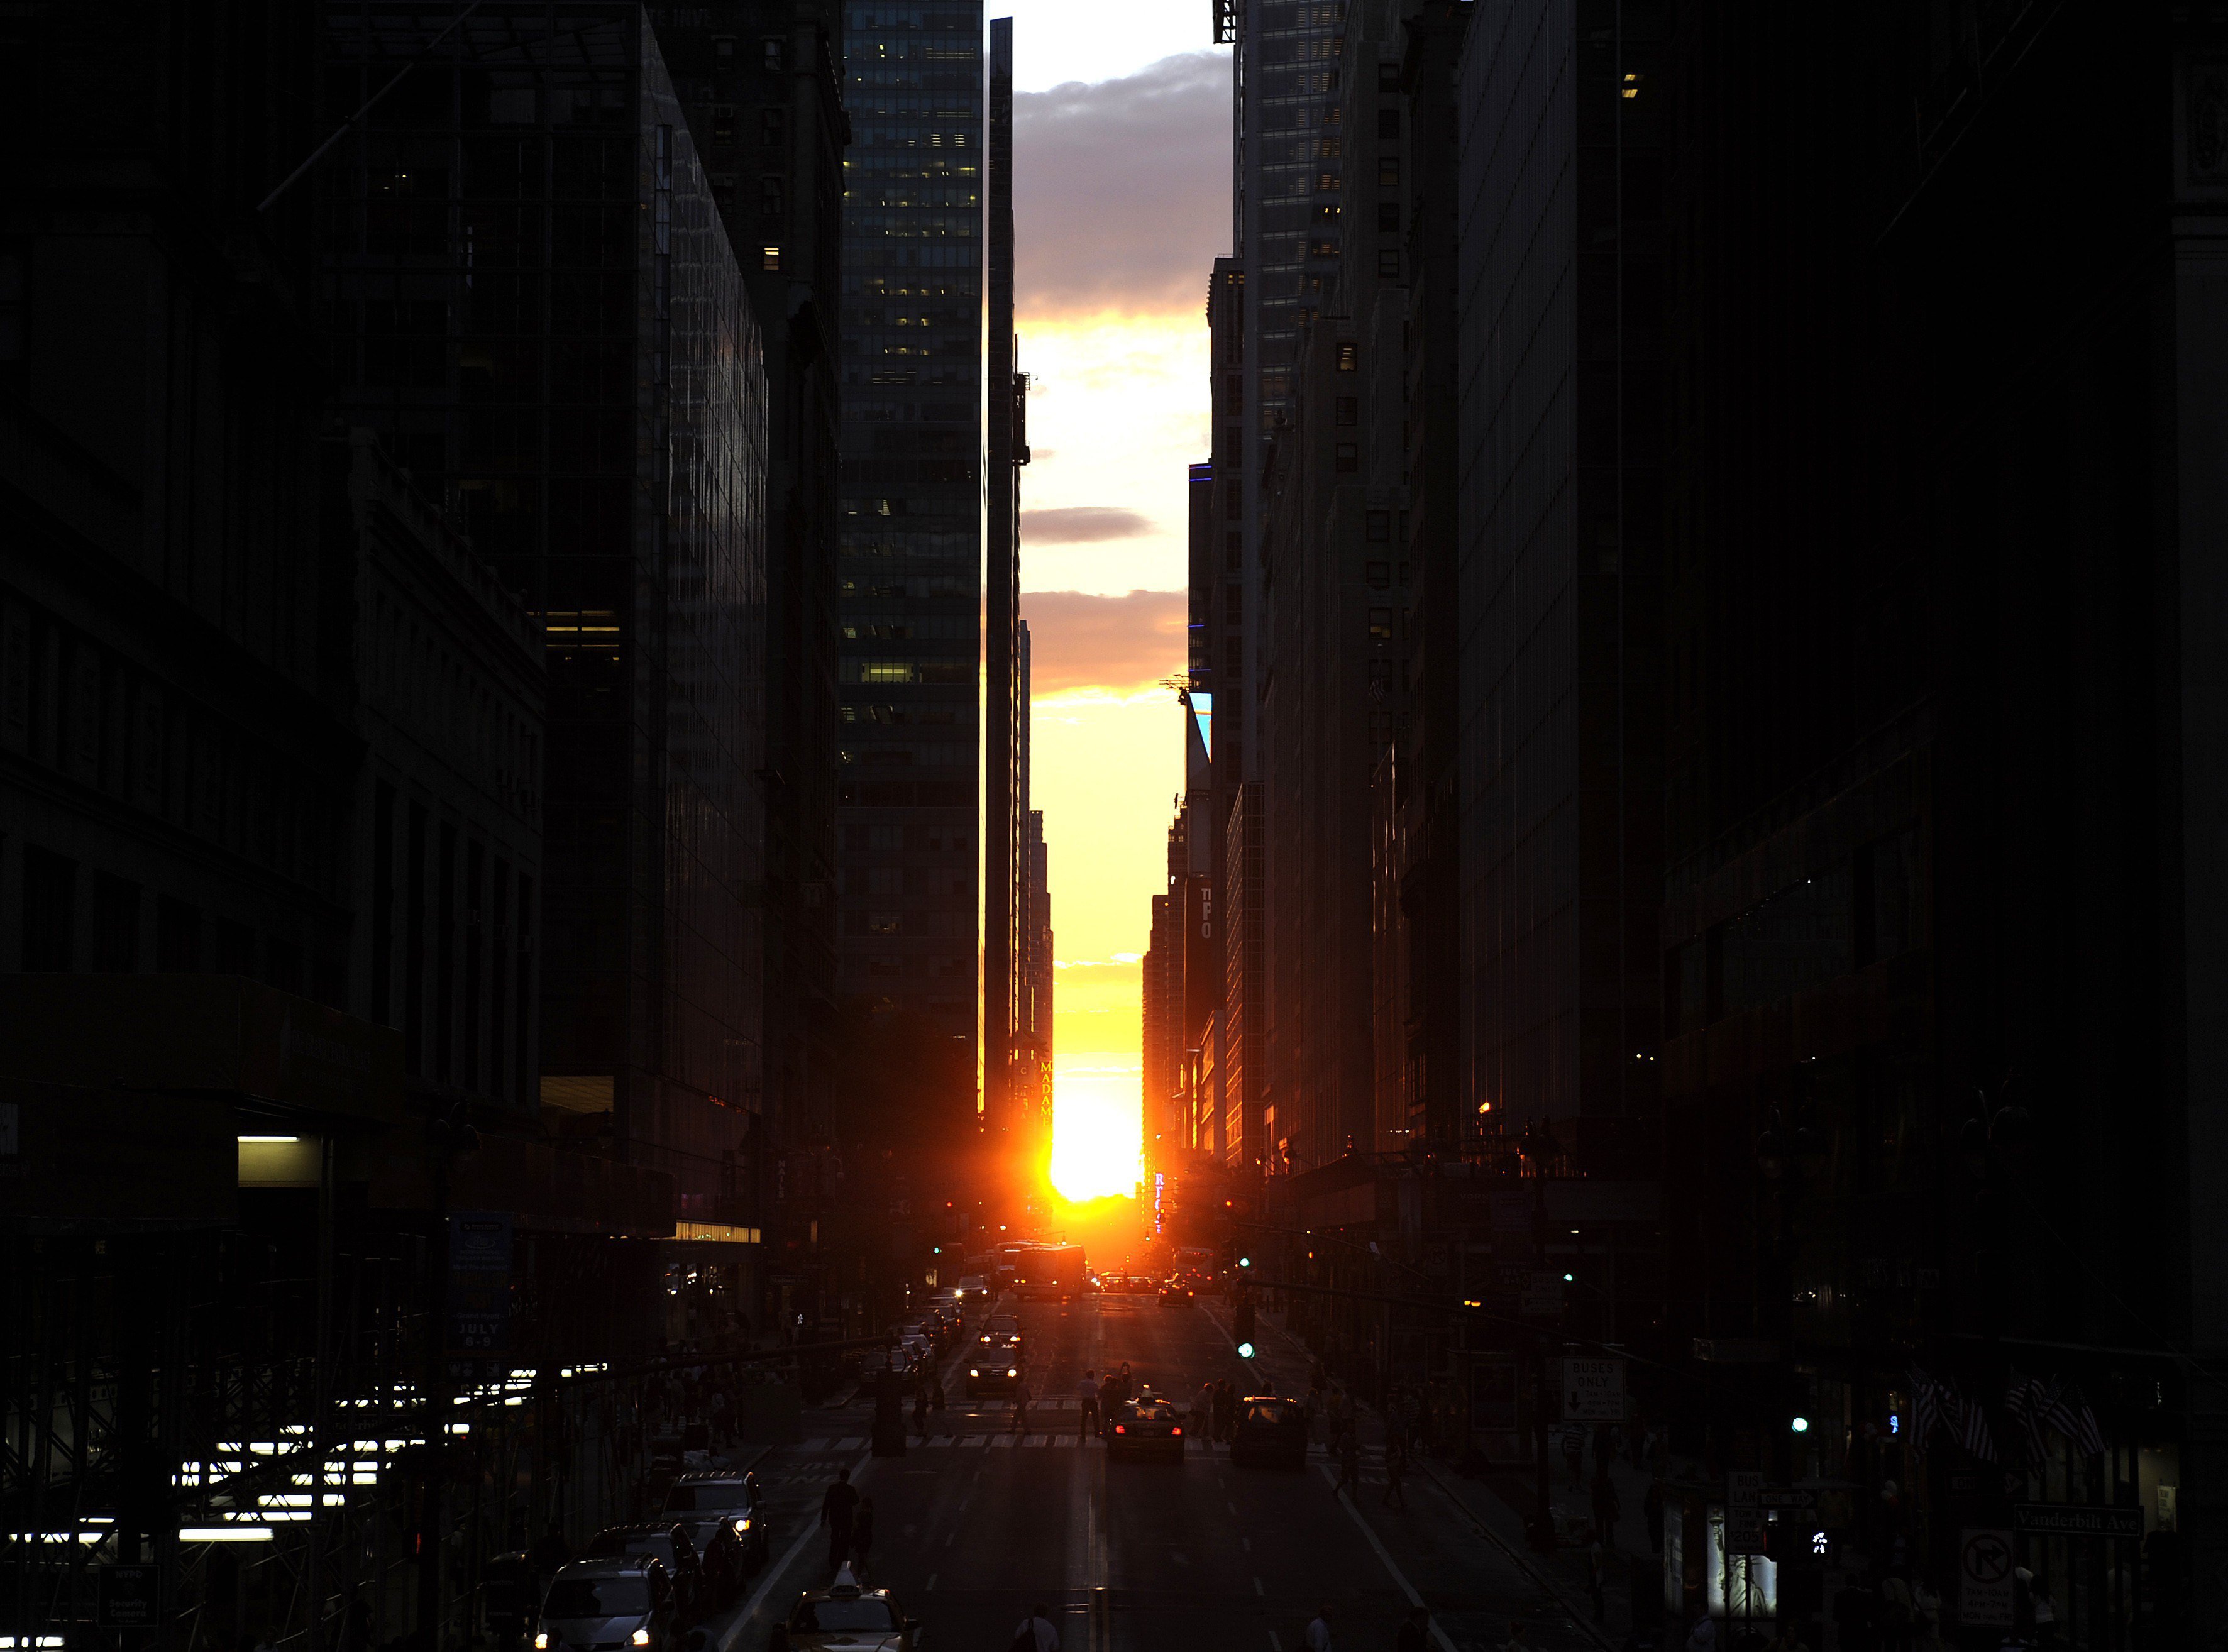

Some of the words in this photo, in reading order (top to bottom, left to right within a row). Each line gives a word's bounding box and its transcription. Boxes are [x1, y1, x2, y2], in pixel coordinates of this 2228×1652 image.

[1040, 1062, 1052, 1127] MADAME
[459, 1323, 499, 1335] JULY
[1573, 1363, 1613, 1374] BUSES
[1578, 1377, 1609, 1387] ONLY
[1738, 1475, 1759, 1487] BUS
[1734, 1491, 1756, 1502] LAN
[1734, 1510, 1751, 1518] TOW
[2019, 1510, 2101, 1529] Vanderbilt
[2106, 1516, 2137, 1531] Ave
[116, 1570, 143, 1578] NYPD
[109, 1599, 148, 1609] Security
[110, 1609, 146, 1617] Camera
[1963, 1612, 1982, 1621] MON
[1999, 1612, 2013, 1621] FRI
